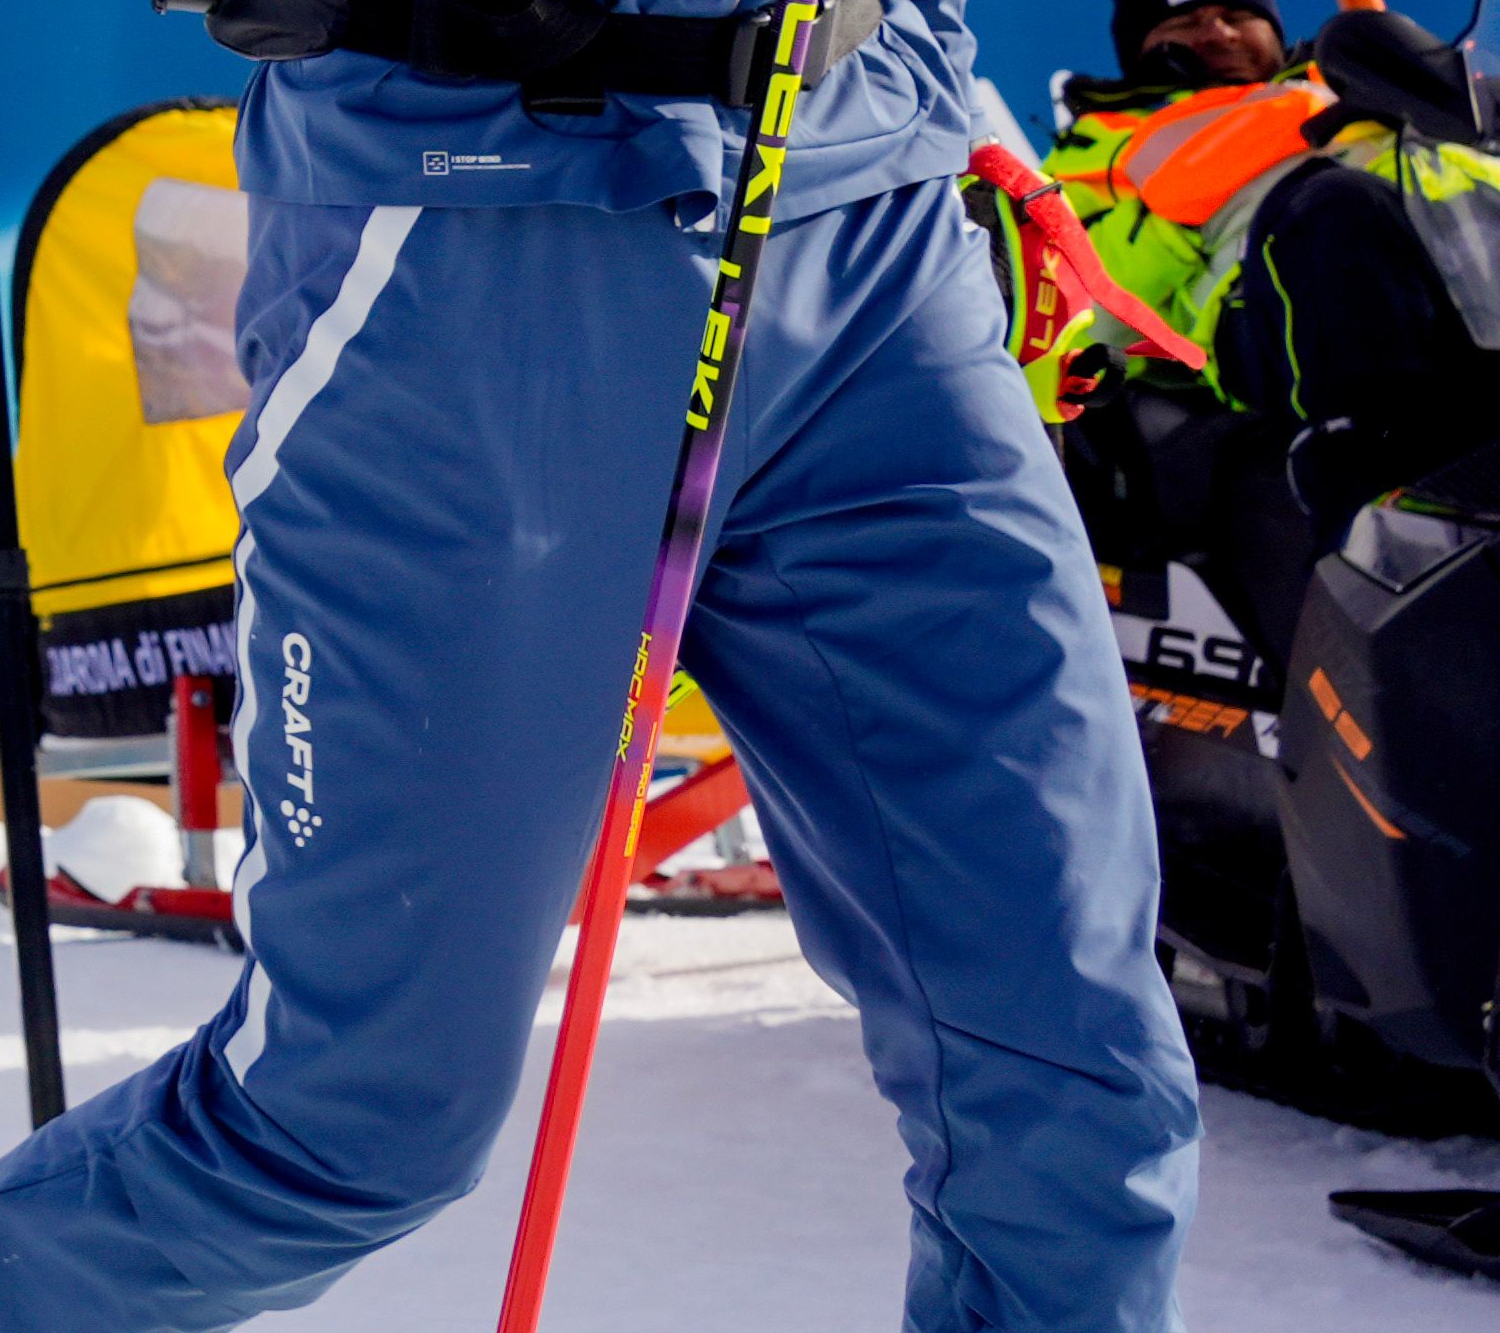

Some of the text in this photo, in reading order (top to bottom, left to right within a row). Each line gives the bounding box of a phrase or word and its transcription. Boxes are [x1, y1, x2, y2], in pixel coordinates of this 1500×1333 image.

[738, 2, 818, 235] LEKI
[134, 631, 168, 686] di
[282, 632, 314, 805] CRAFT
